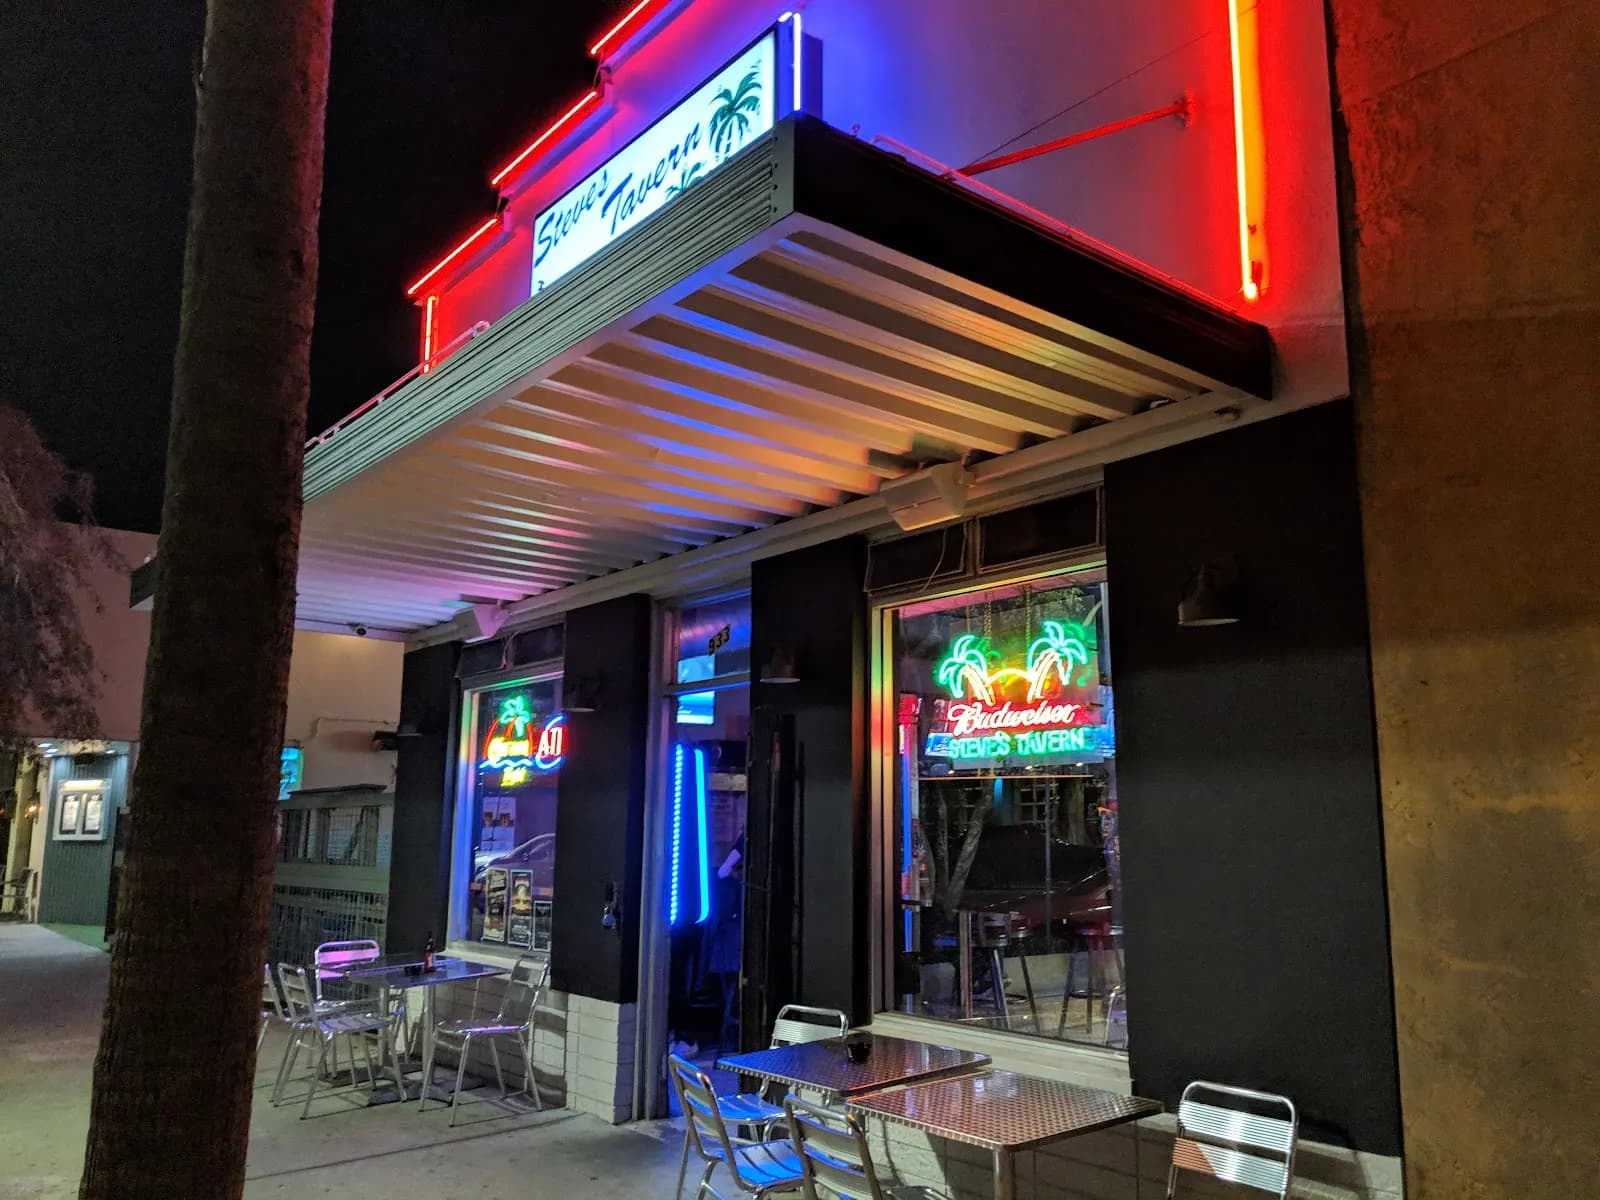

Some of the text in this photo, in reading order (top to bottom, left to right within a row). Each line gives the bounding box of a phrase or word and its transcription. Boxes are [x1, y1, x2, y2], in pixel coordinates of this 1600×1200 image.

[602, 122, 702, 235] Tavern
[947, 700, 1080, 736] Budweiser
[1014, 728, 1085, 756] TAVERN
